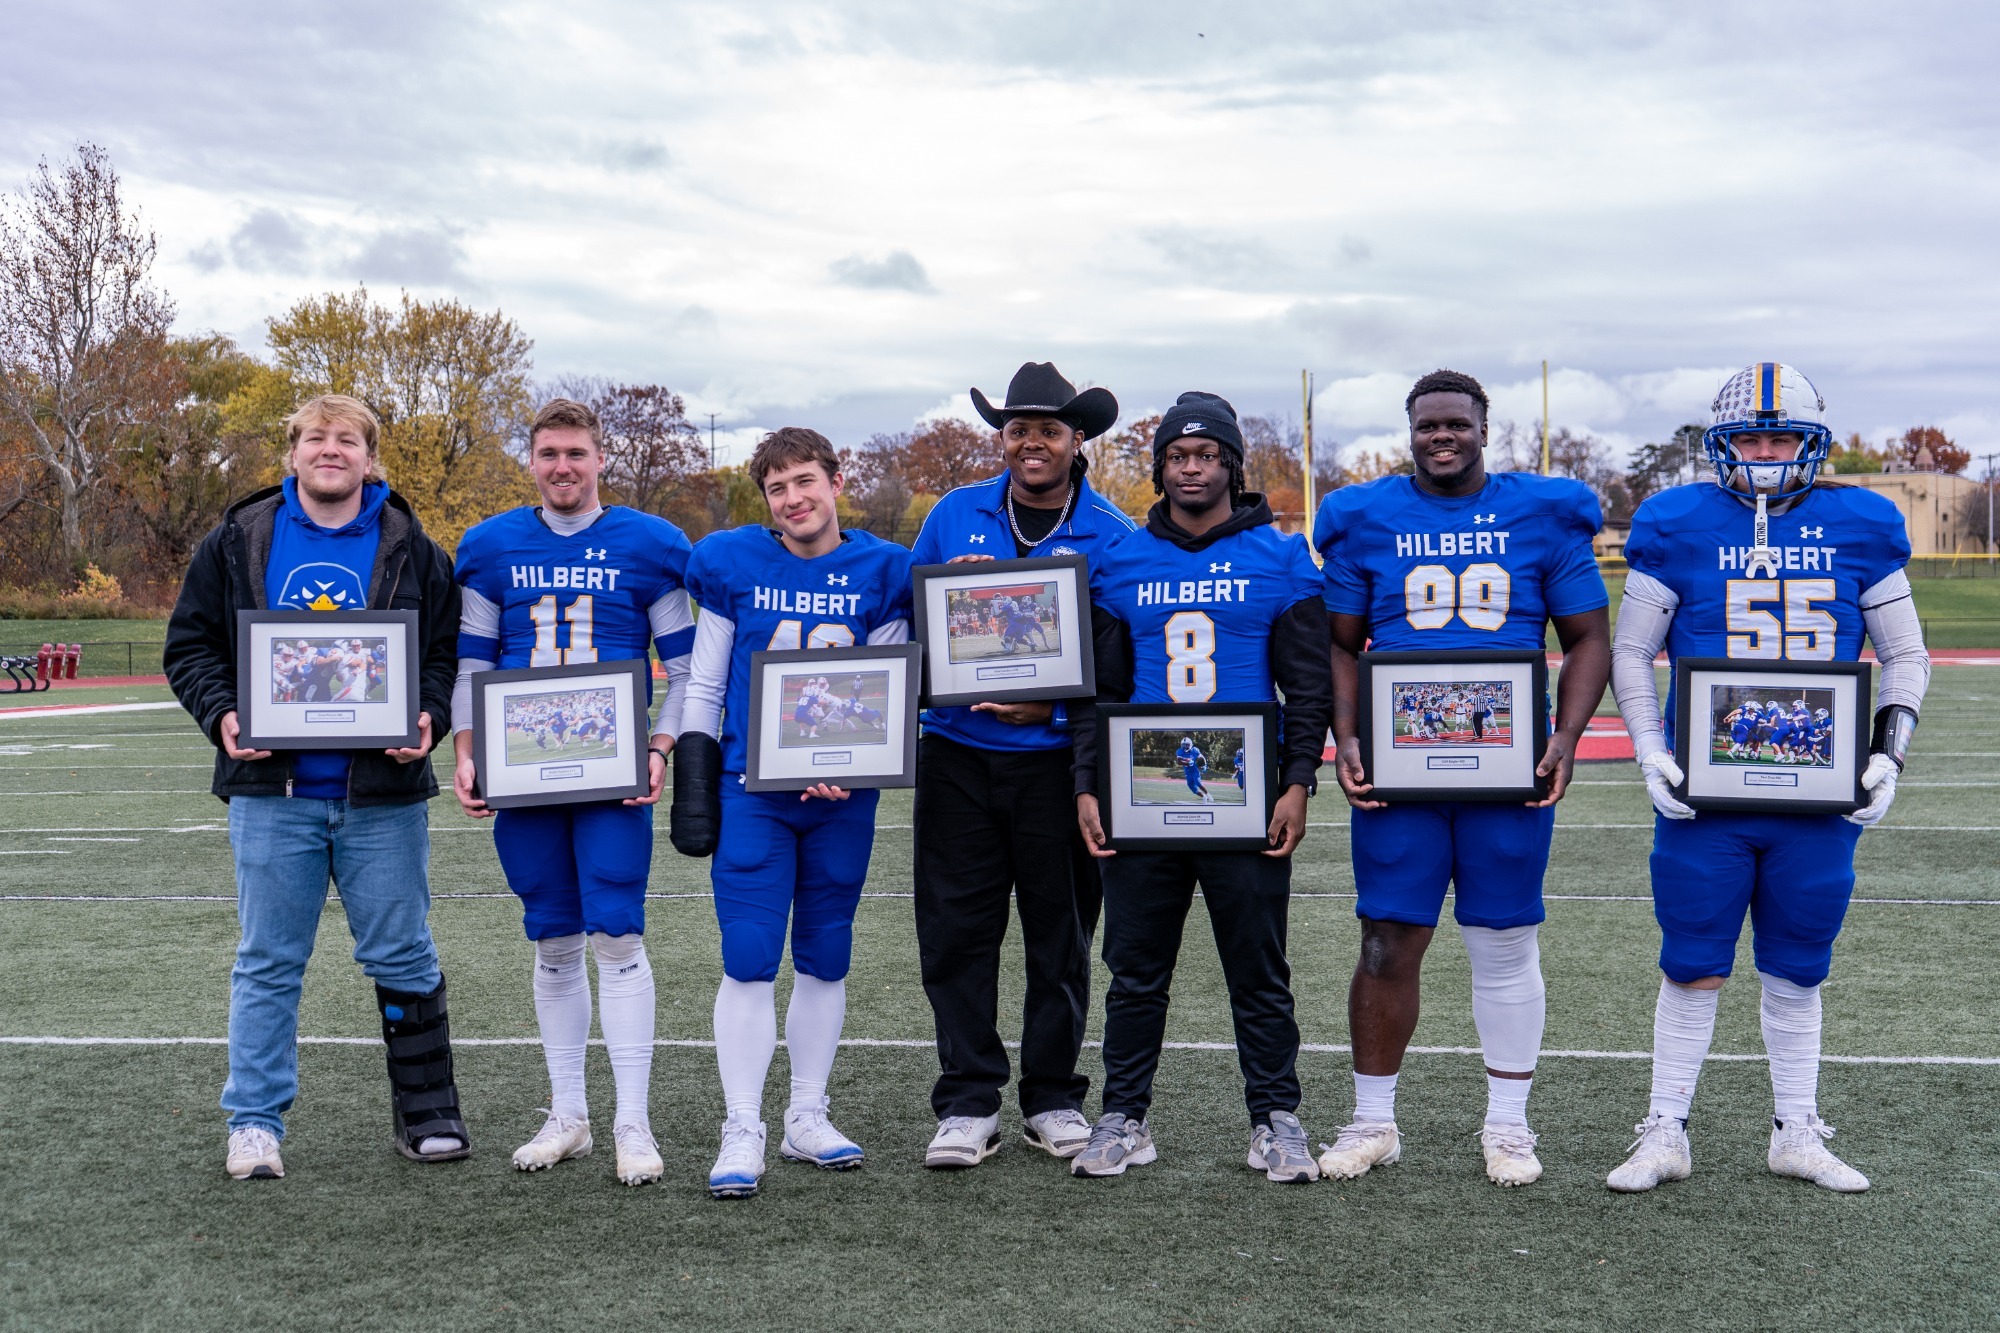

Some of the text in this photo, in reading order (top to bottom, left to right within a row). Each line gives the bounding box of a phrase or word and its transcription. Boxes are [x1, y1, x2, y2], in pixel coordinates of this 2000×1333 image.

[1396, 531, 1510, 557] HILBERT
[1756, 521, 1766, 546] NXTRND
[1718, 546, 1837, 571] HIBERT
[511, 565, 621, 592] HILBERT
[754, 585, 861, 616] HILBERT
[1137, 579, 1250, 606] HILBERT
[530, 595, 598, 668] 11
[1726, 579, 1838, 662] 55
[1164, 610, 1217, 703] 8
